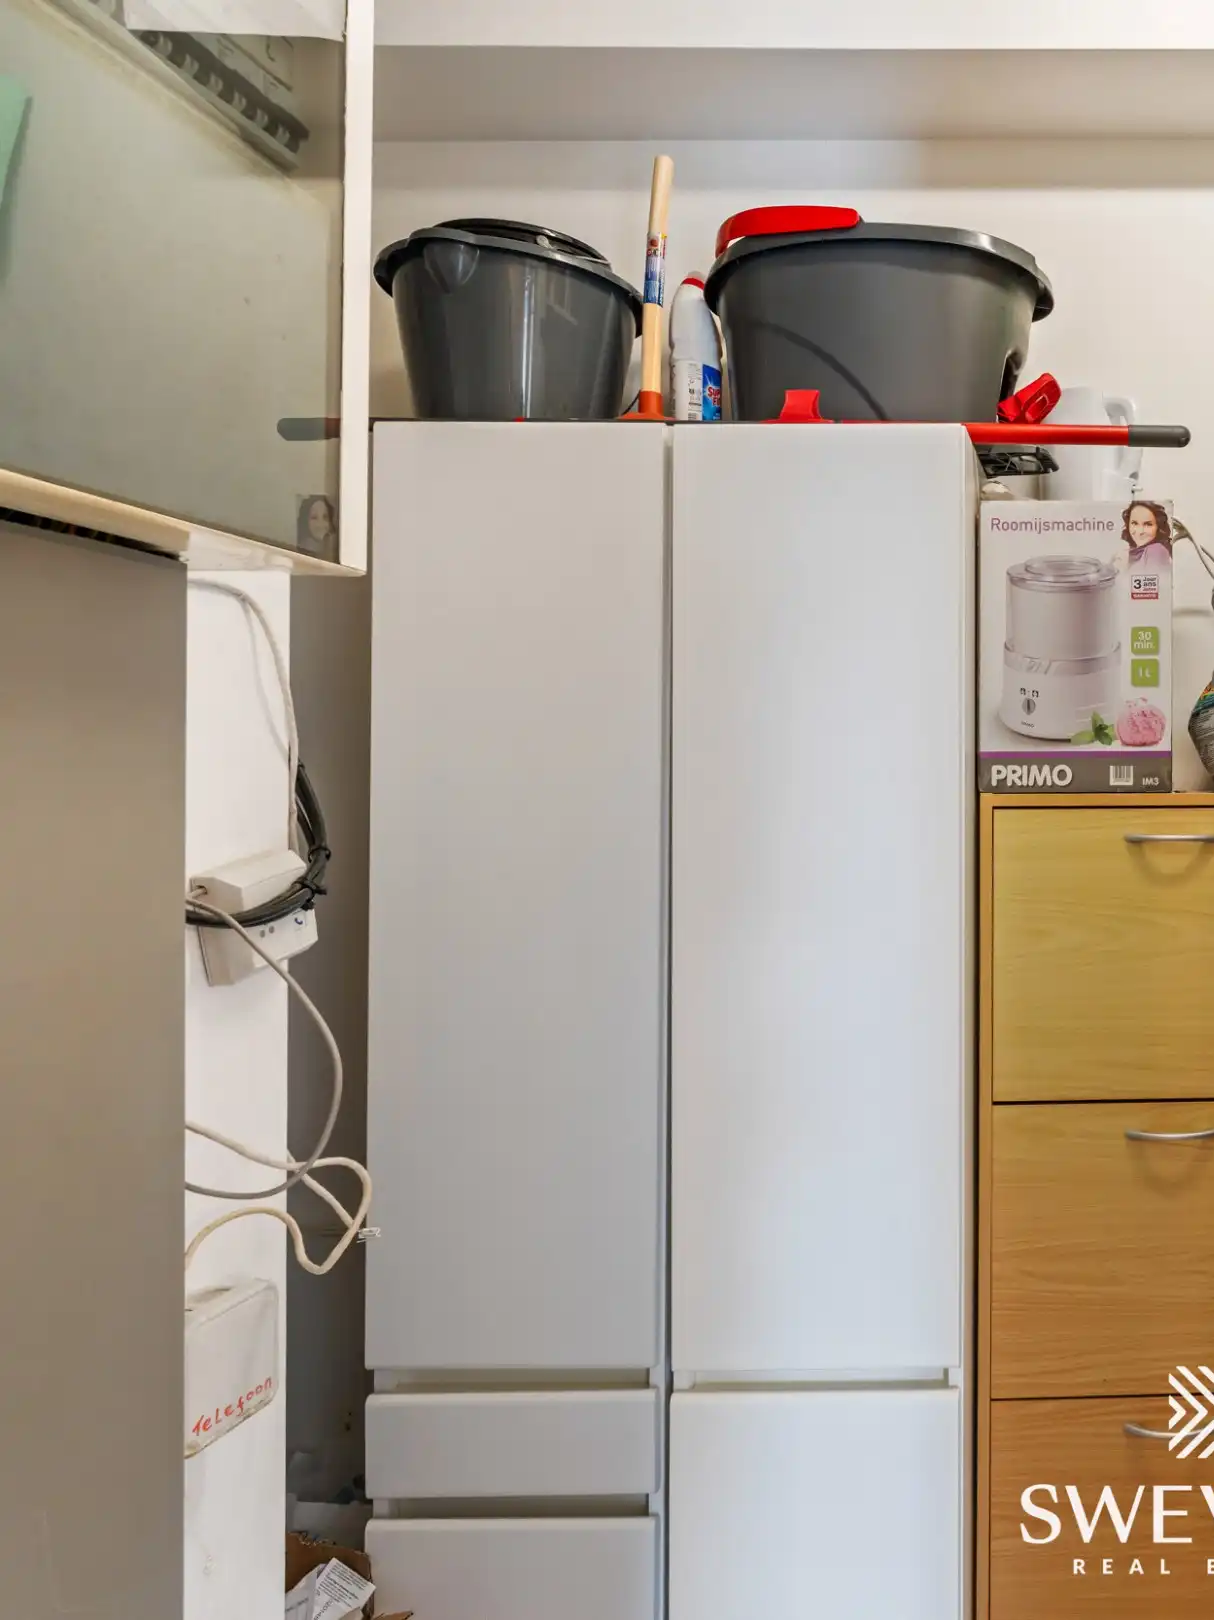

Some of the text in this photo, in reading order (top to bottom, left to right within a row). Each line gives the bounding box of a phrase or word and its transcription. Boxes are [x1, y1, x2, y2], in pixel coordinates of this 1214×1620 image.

[990, 517, 1114, 534] Roomijsmachine
[1133, 578, 1141, 589] 3
[1138, 631, 1152, 640] 30
[991, 764, 1073, 787] PRIMO
[1142, 777, 1160, 786] IM3
